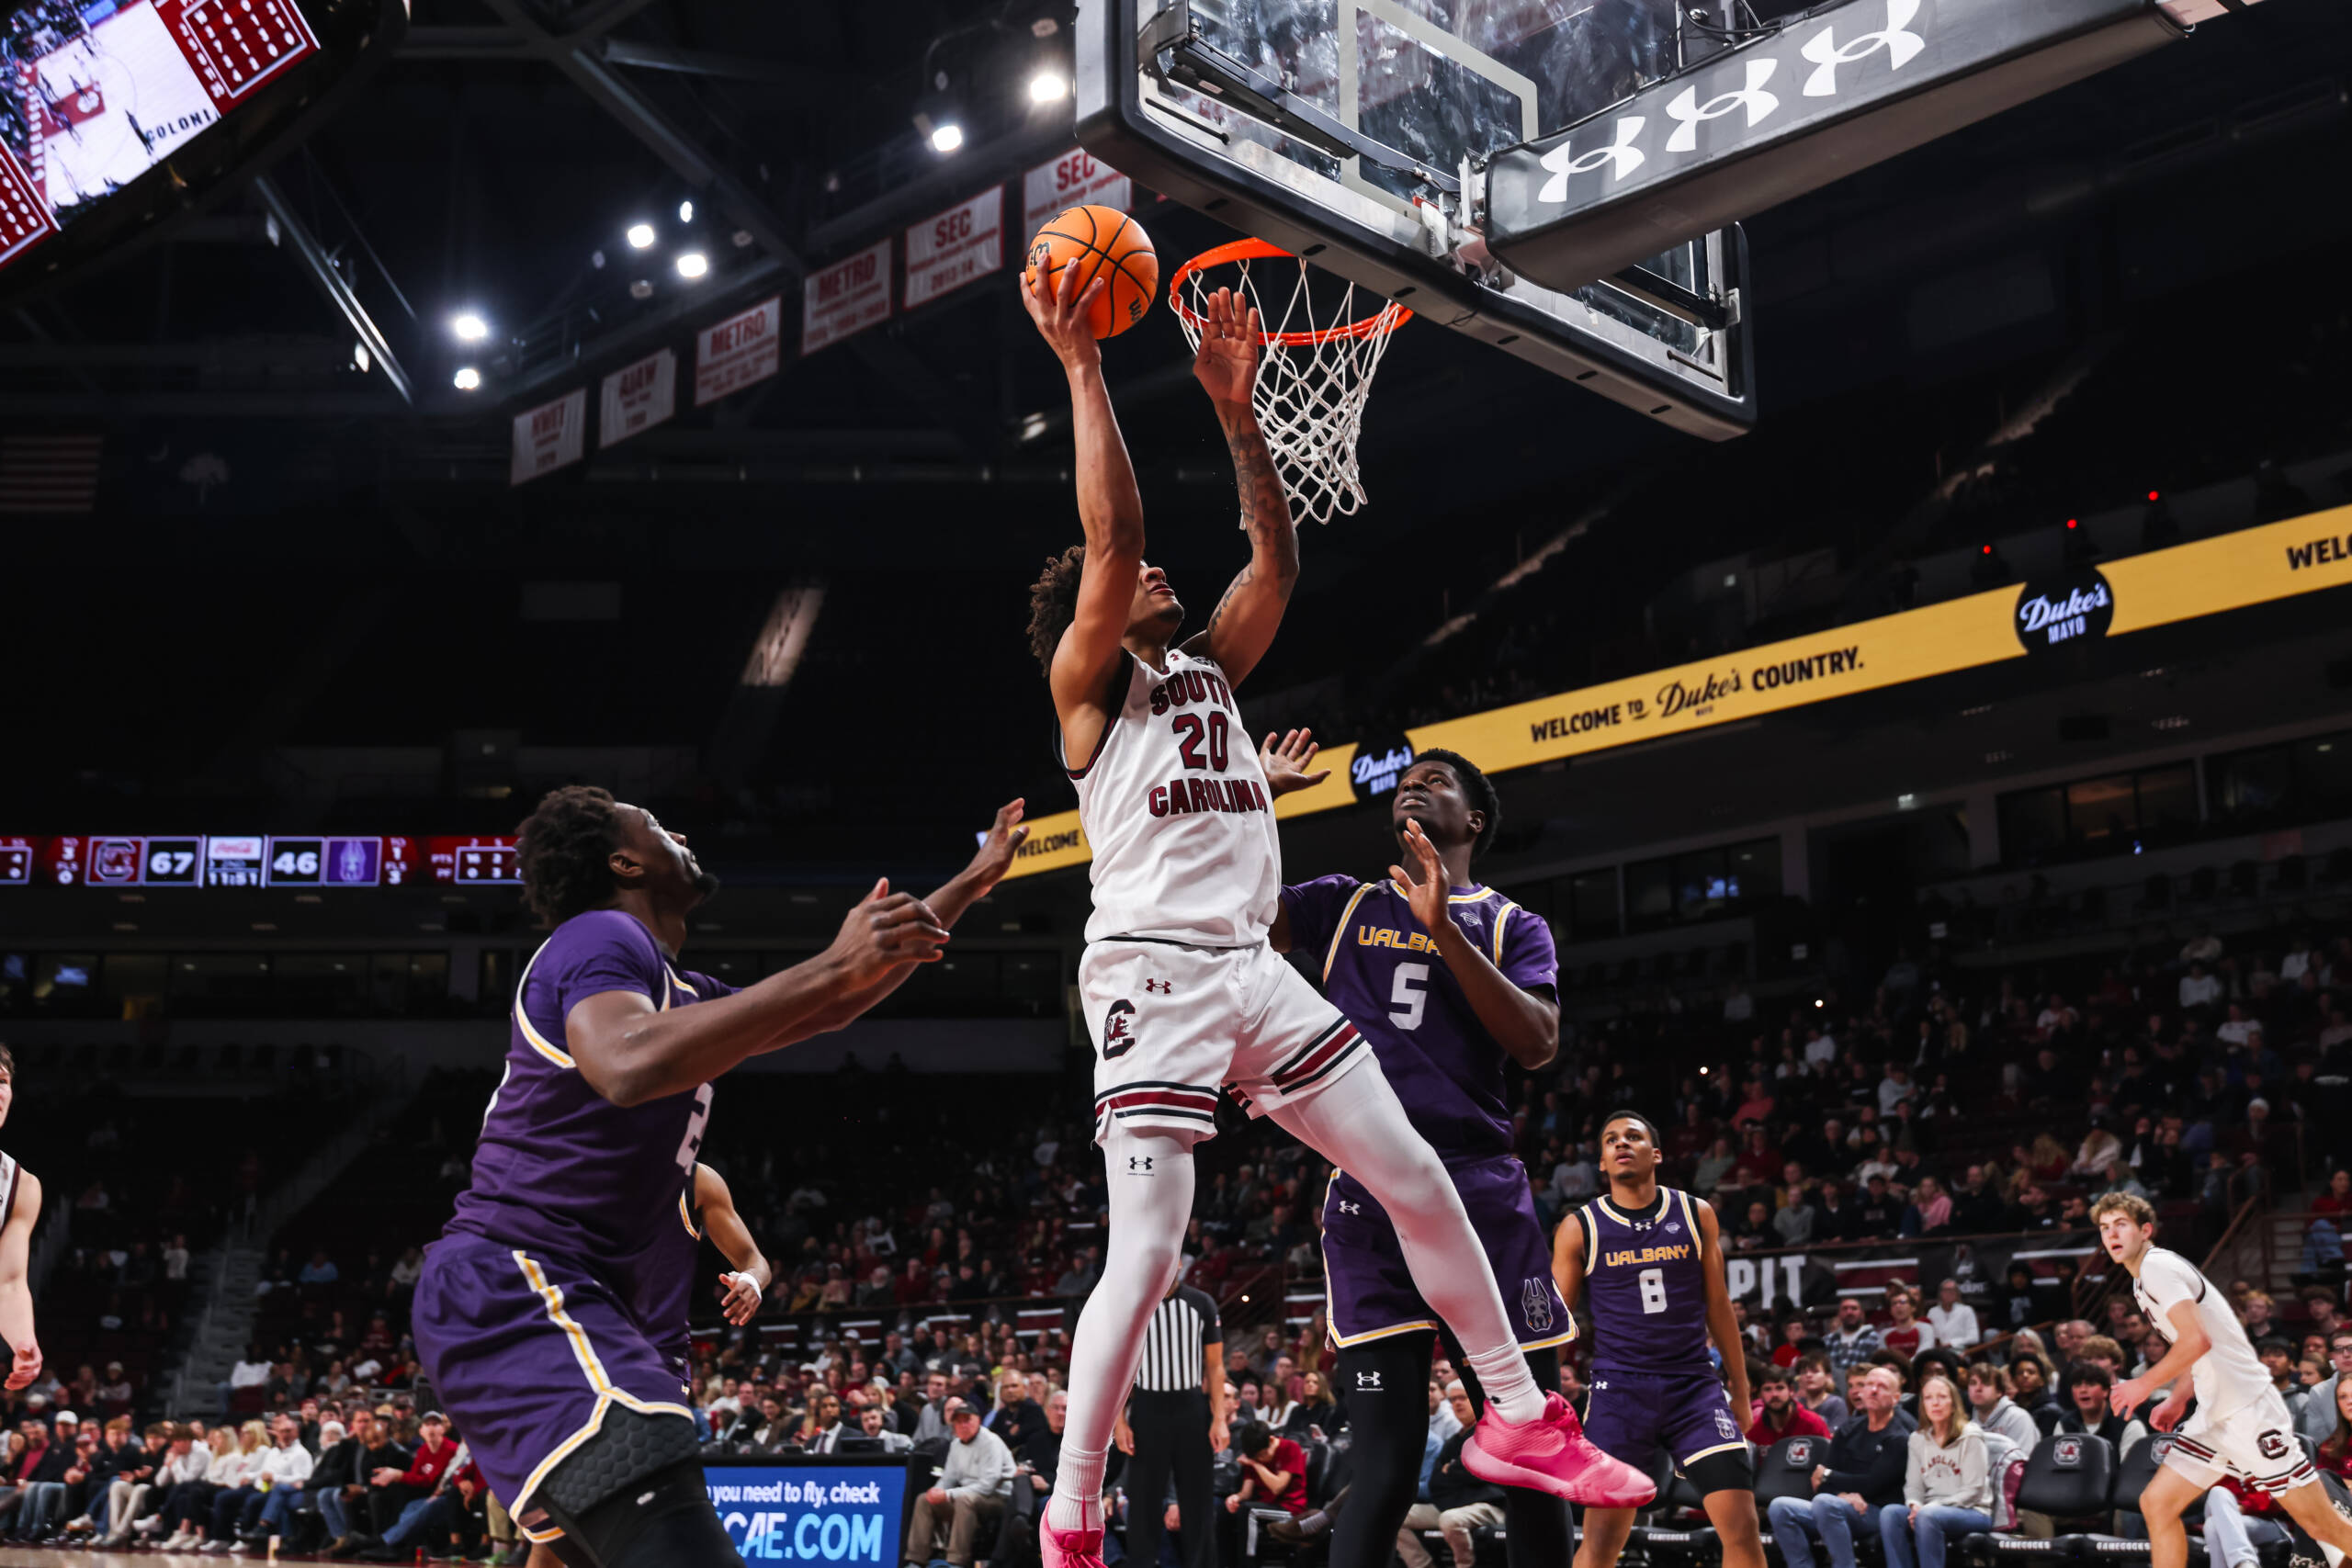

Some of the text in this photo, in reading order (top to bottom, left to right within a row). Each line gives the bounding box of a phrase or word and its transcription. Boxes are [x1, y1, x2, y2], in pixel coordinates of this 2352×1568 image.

[1057, 152, 1095, 191] SEC
[935, 209, 974, 249] SEC
[818, 252, 876, 304] METRO
[710, 309, 766, 358] METRO
[2019, 582, 2109, 633] Duke's
[2047, 615, 2086, 645] MAYO
[1149, 670, 1233, 716] SOUTH
[1531, 646, 1865, 742] WELCOME TO Duke's COUNTRY.
[1171, 711, 1228, 773] 20
[1148, 778, 1268, 818] CAROLINA
[150, 852, 195, 874] 67
[273, 852, 319, 874] 46
[1016, 829, 1080, 859] WELCOME
[1358, 926, 1481, 956] UALBA
[1388, 962, 1430, 1031] 5
[1605, 1245, 1690, 1267] UALBANY
[1639, 1269, 1668, 1314] 8
[713, 1485, 741, 1506] you
[742, 1480, 782, 1503] need
[785, 1483, 802, 1503] to
[803, 1481, 828, 1508] fly,
[830, 1481, 880, 1504] check
[717, 1512, 884, 1562] CAE.COM
